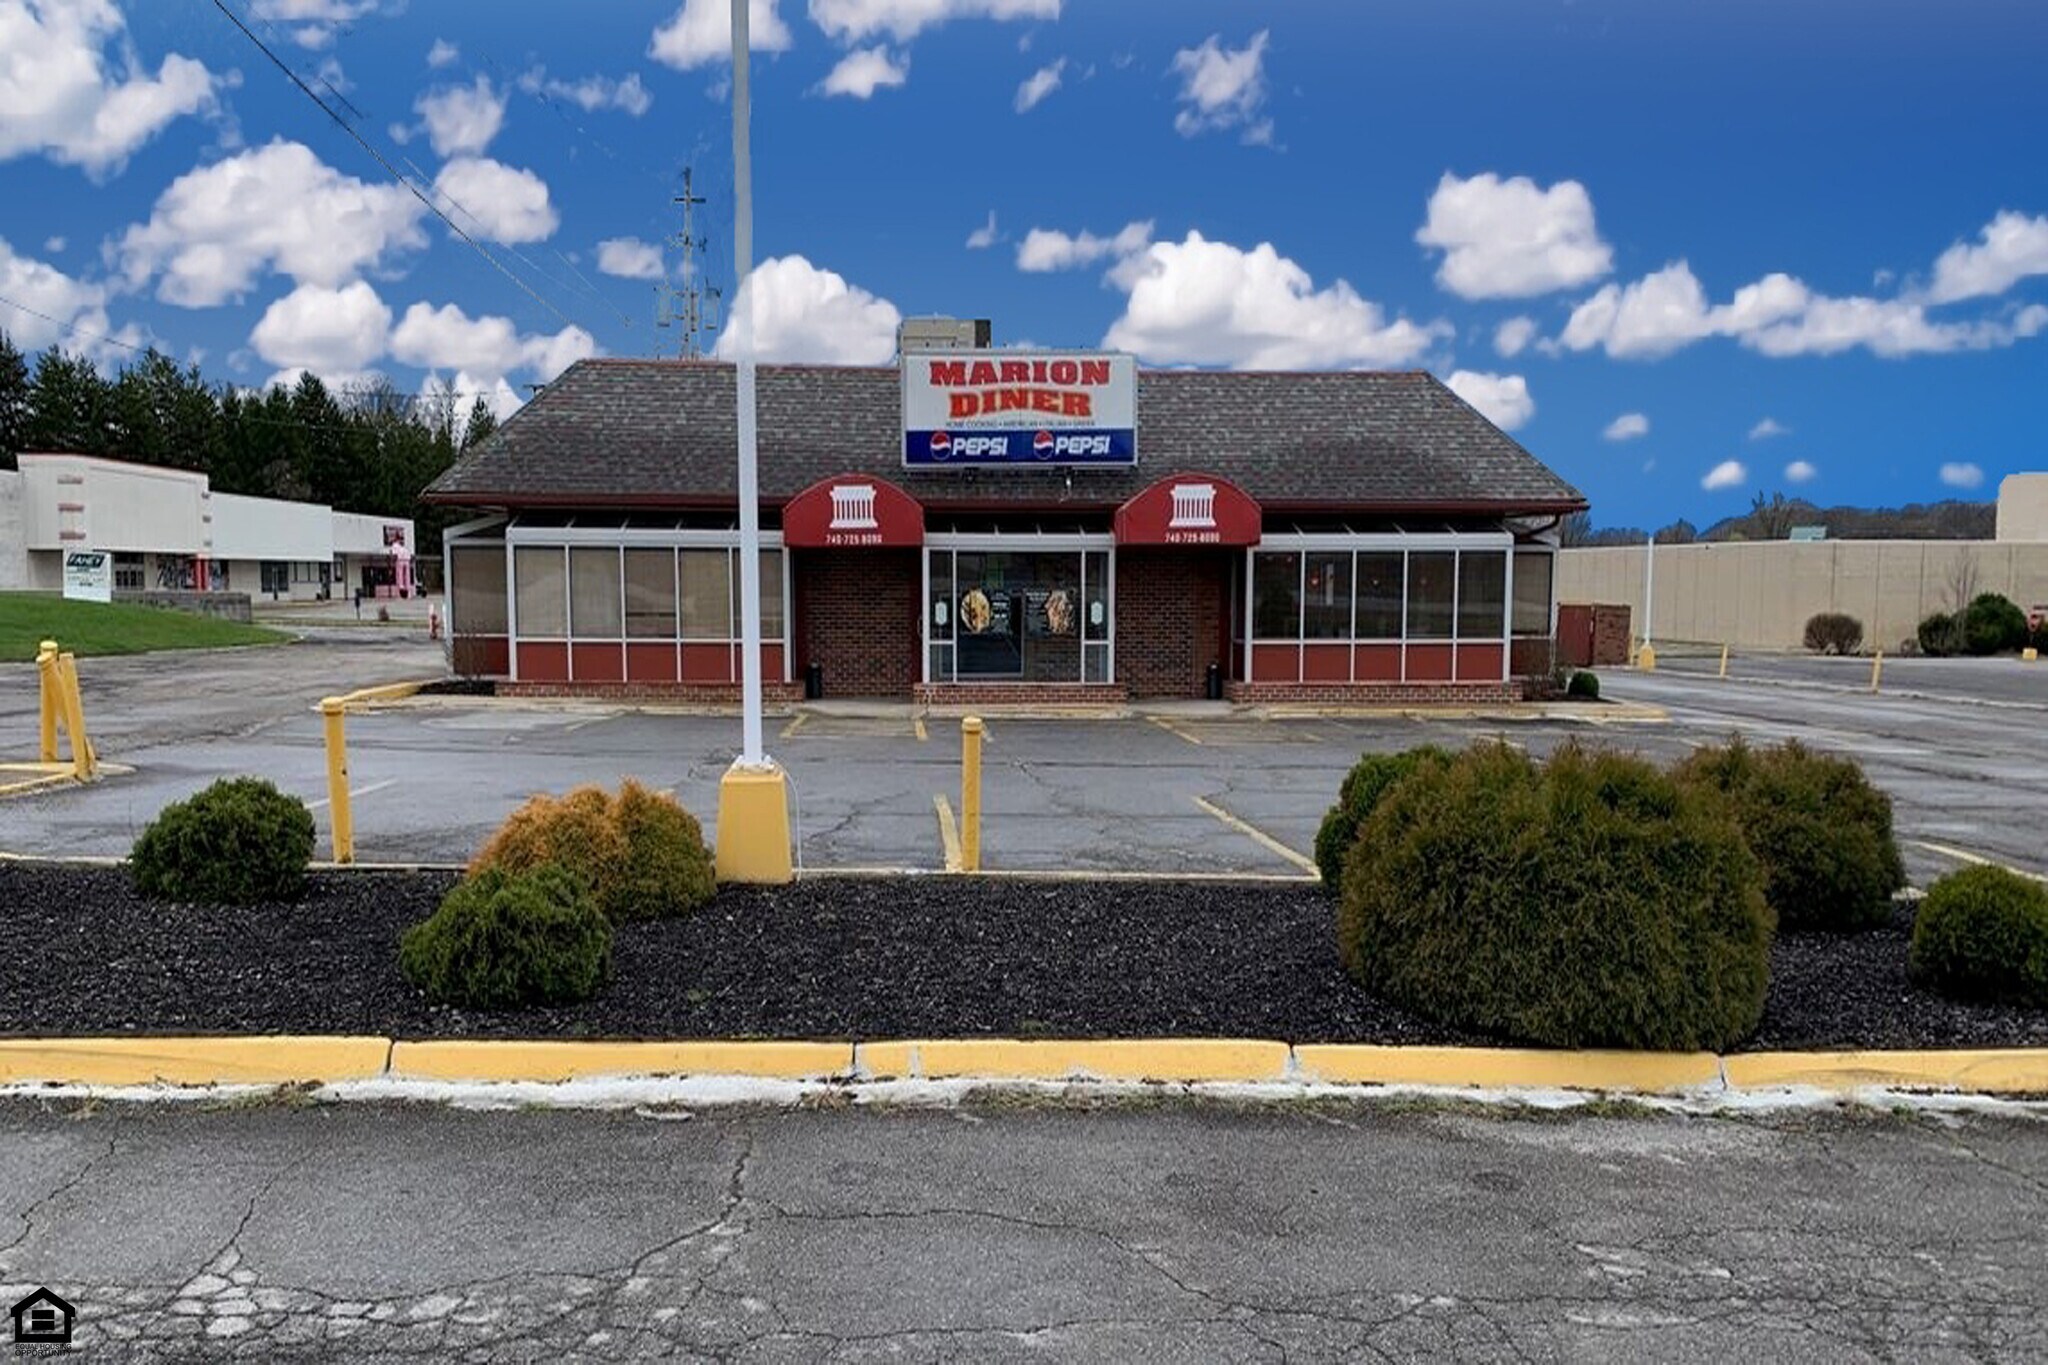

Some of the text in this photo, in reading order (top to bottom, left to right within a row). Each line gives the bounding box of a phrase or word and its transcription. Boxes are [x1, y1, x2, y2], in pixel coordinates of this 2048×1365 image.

[929, 360, 1110, 386] MARION
[949, 386, 1092, 418] DINER
[952, 437, 1008, 456] PEPSI
[1055, 435, 1111, 455] PEPSI
